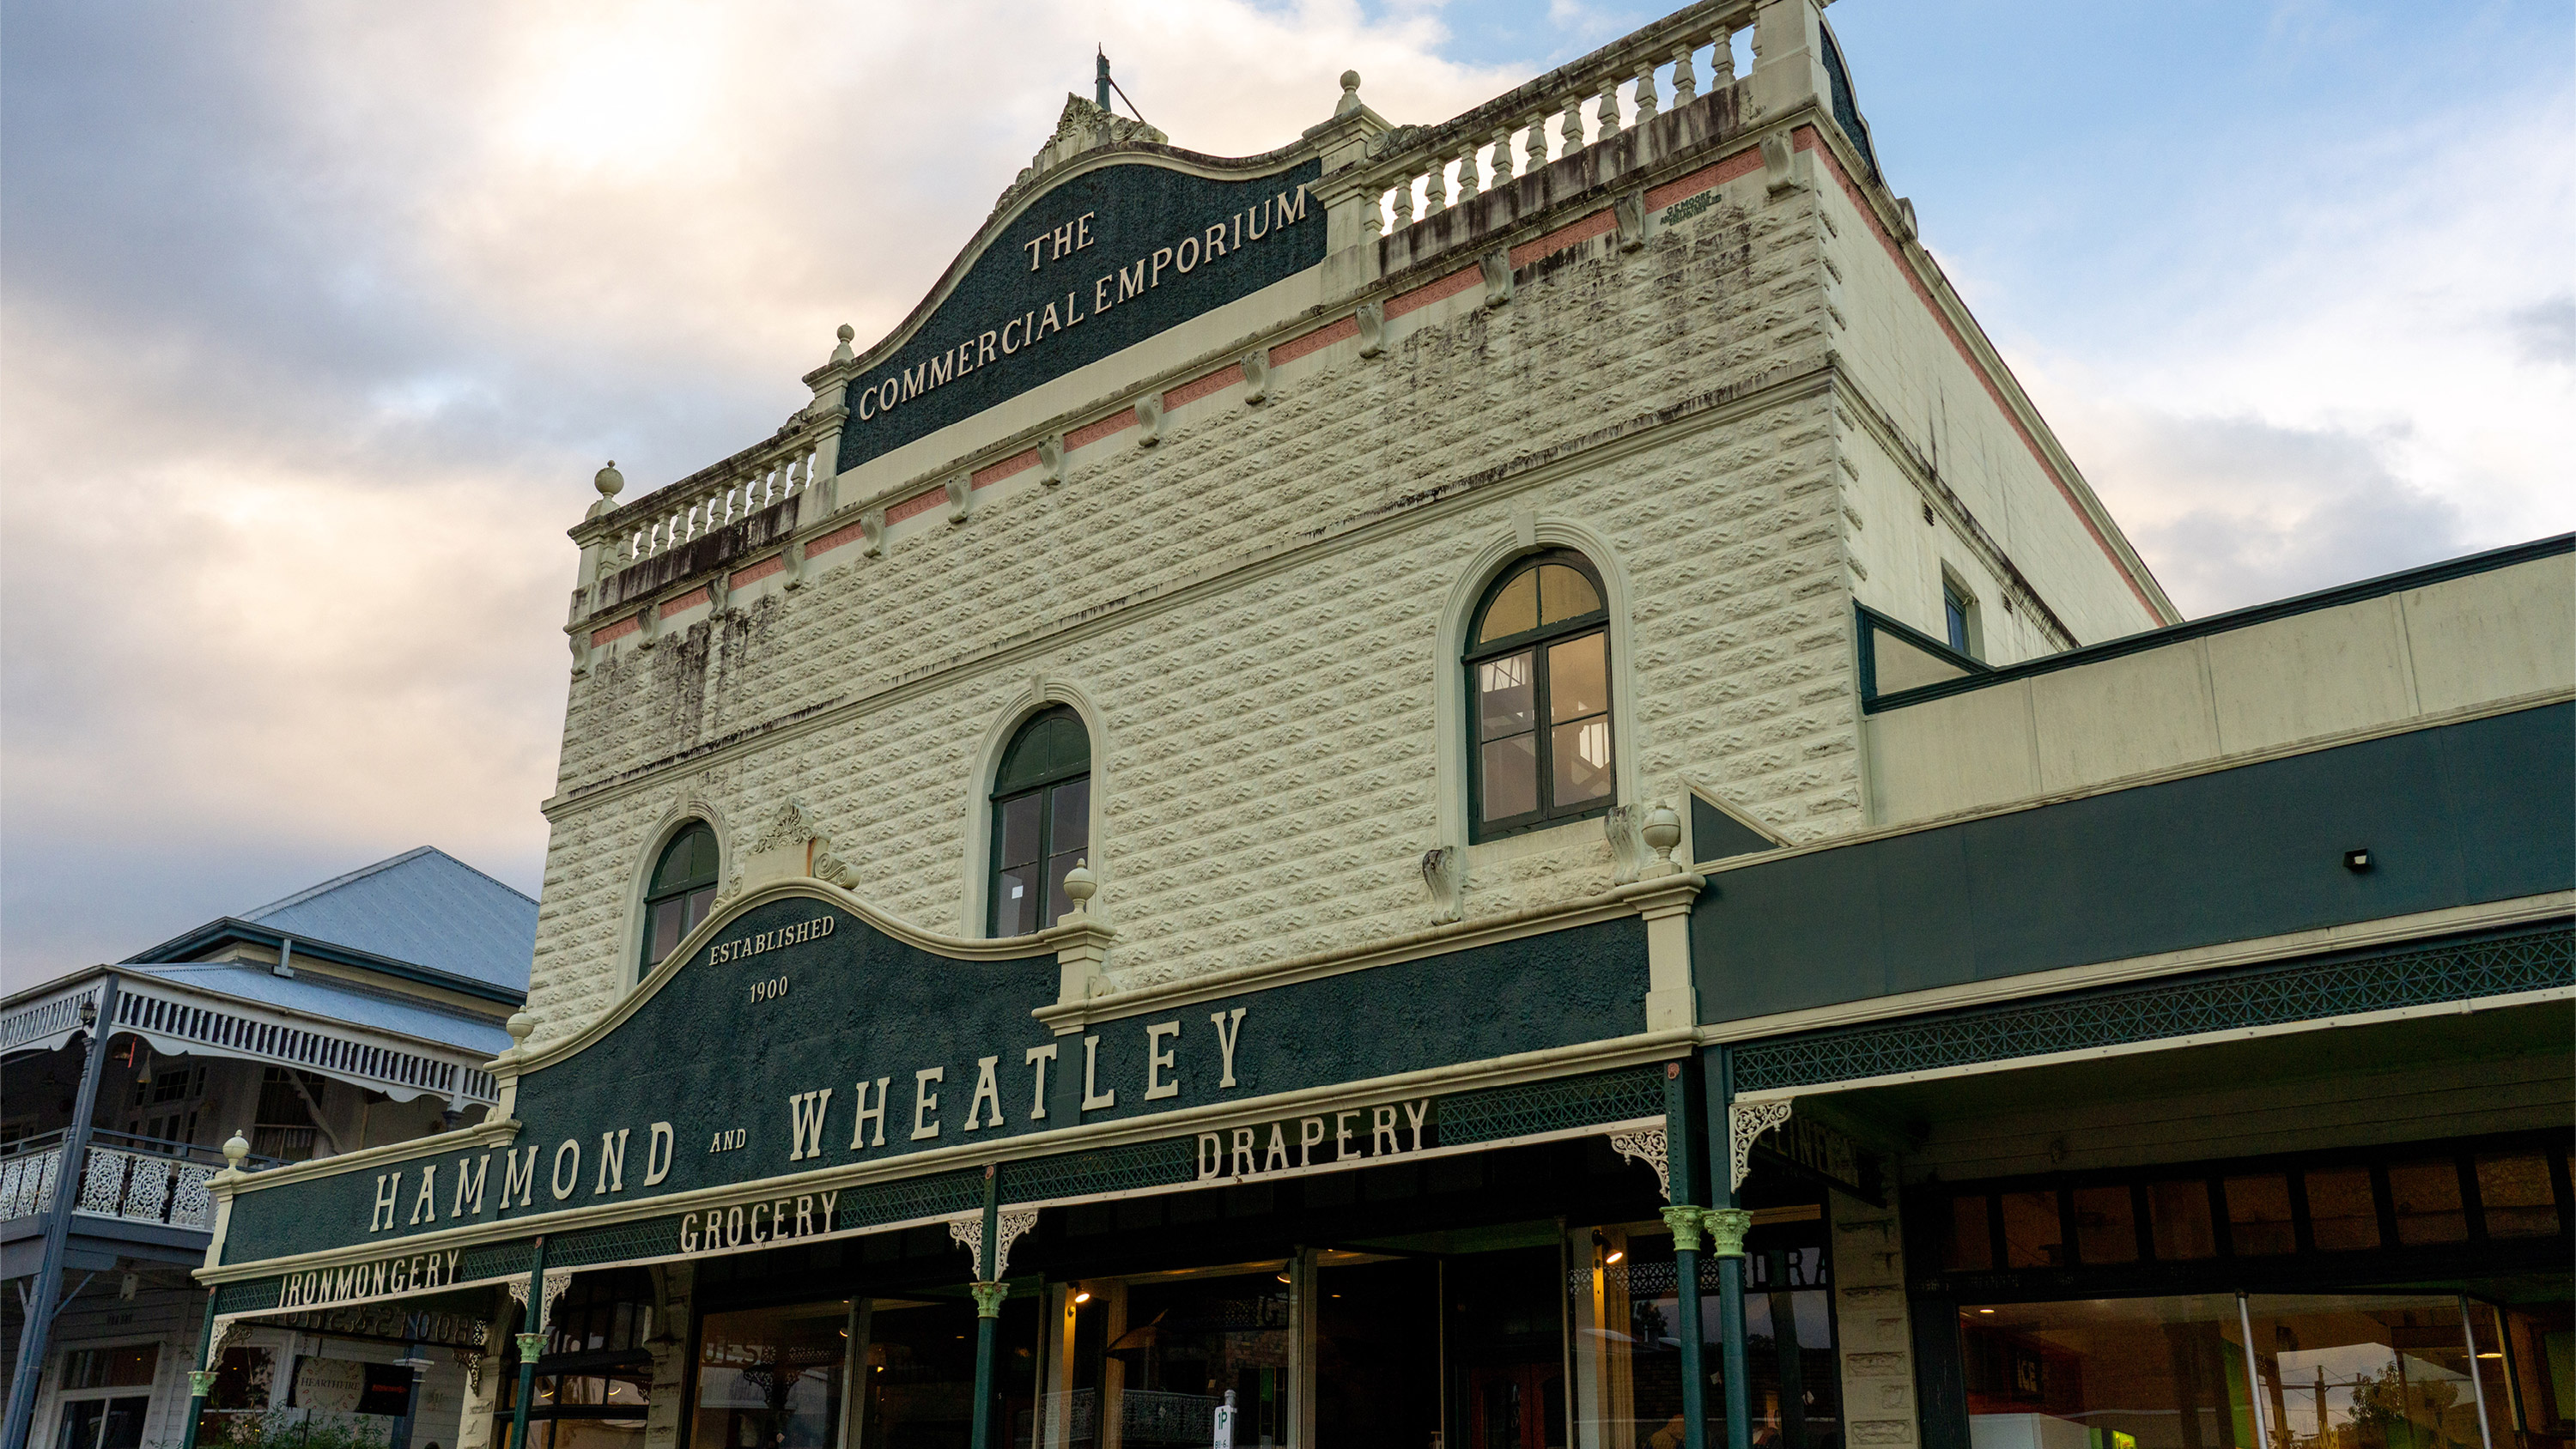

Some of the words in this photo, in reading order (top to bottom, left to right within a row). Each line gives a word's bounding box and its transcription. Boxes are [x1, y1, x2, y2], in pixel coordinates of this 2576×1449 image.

[1024, 211, 1095, 271] THE
[860, 292, 1084, 421] COMMERCIAL
[1094, 184, 1308, 315] EMPORIUM
[708, 915, 835, 966] ESTABLISHED
[750, 976, 788, 1003] 1900
[369, 1121, 674, 1233] HAMMOND
[709, 1128, 746, 1153] AND
[789, 1007, 1247, 1161] WHEATLEY
[1198, 1099, 1430, 1180] DRAPERY
[681, 1191, 838, 1252] GROCERY
[278, 1249, 460, 1307] IRONMONGERY
[301, 1377, 361, 1391] HEARTHFIRE
[1218, 1411, 1228, 1429] 1P
